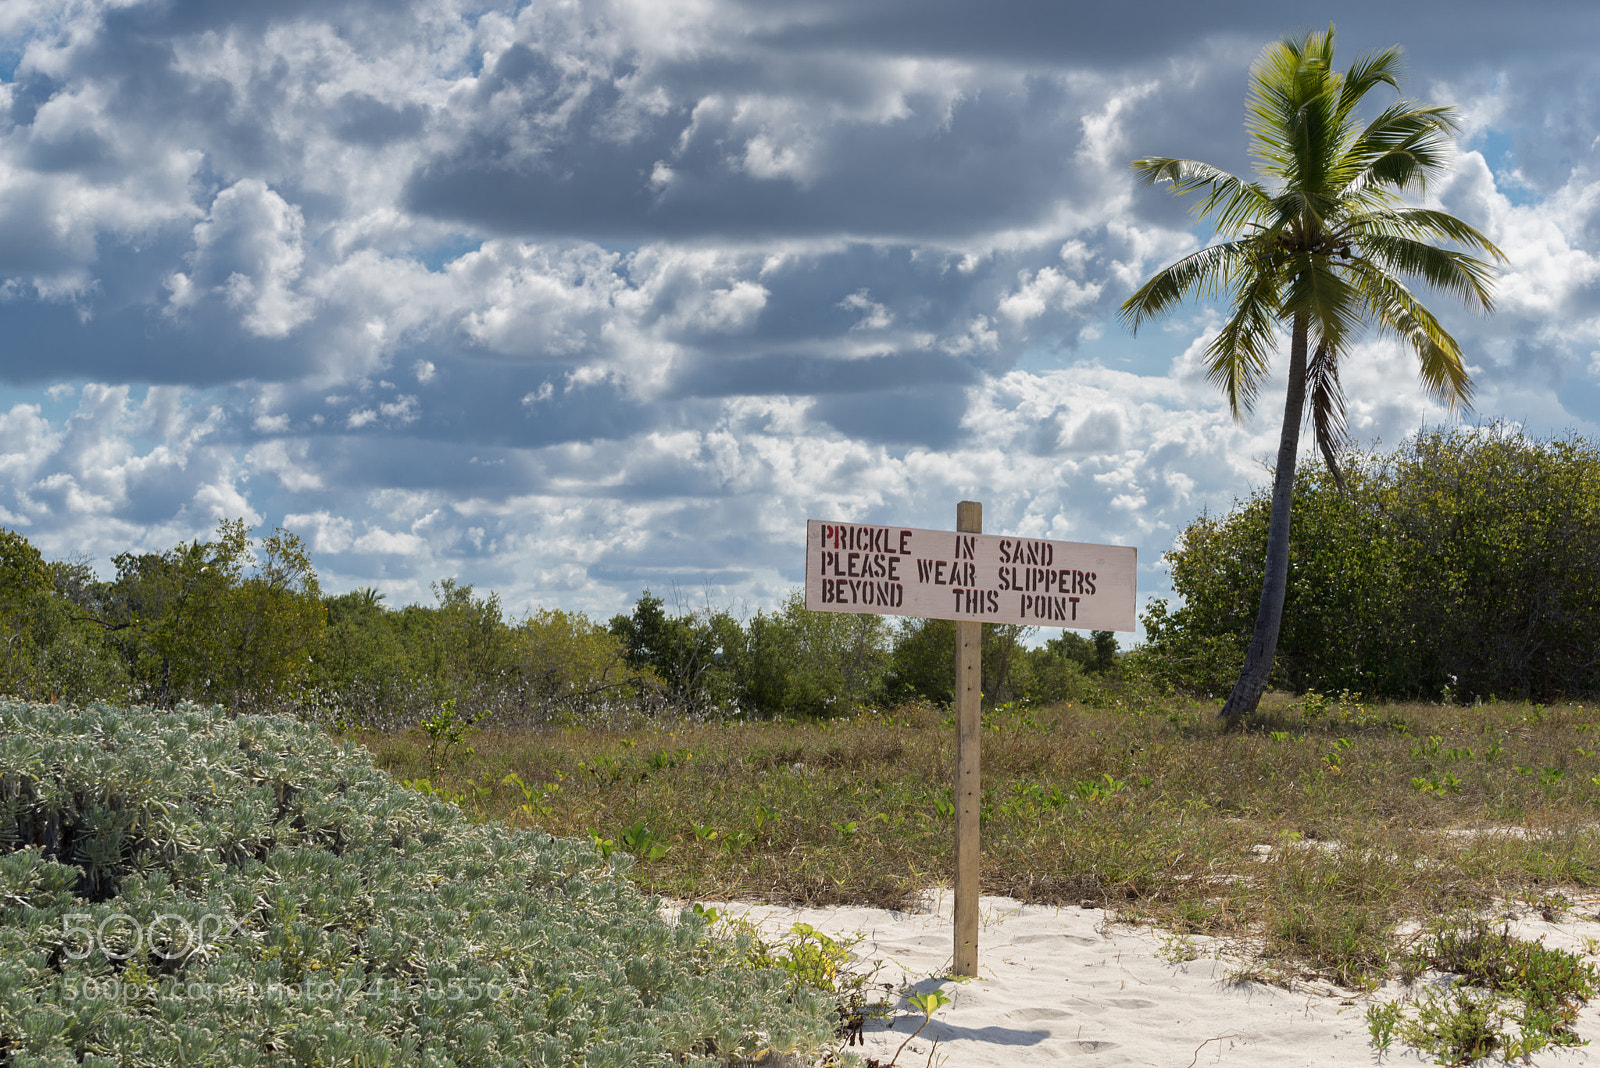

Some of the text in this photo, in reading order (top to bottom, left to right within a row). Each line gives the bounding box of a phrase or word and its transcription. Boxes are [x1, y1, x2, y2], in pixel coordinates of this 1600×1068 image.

[821, 524, 1053, 567] PRICKLE IN SAND
[821, 551, 1097, 595] PLEASE WEAR SLIPPERS
[821, 578, 1080, 621] BEYOND THIS POINT
